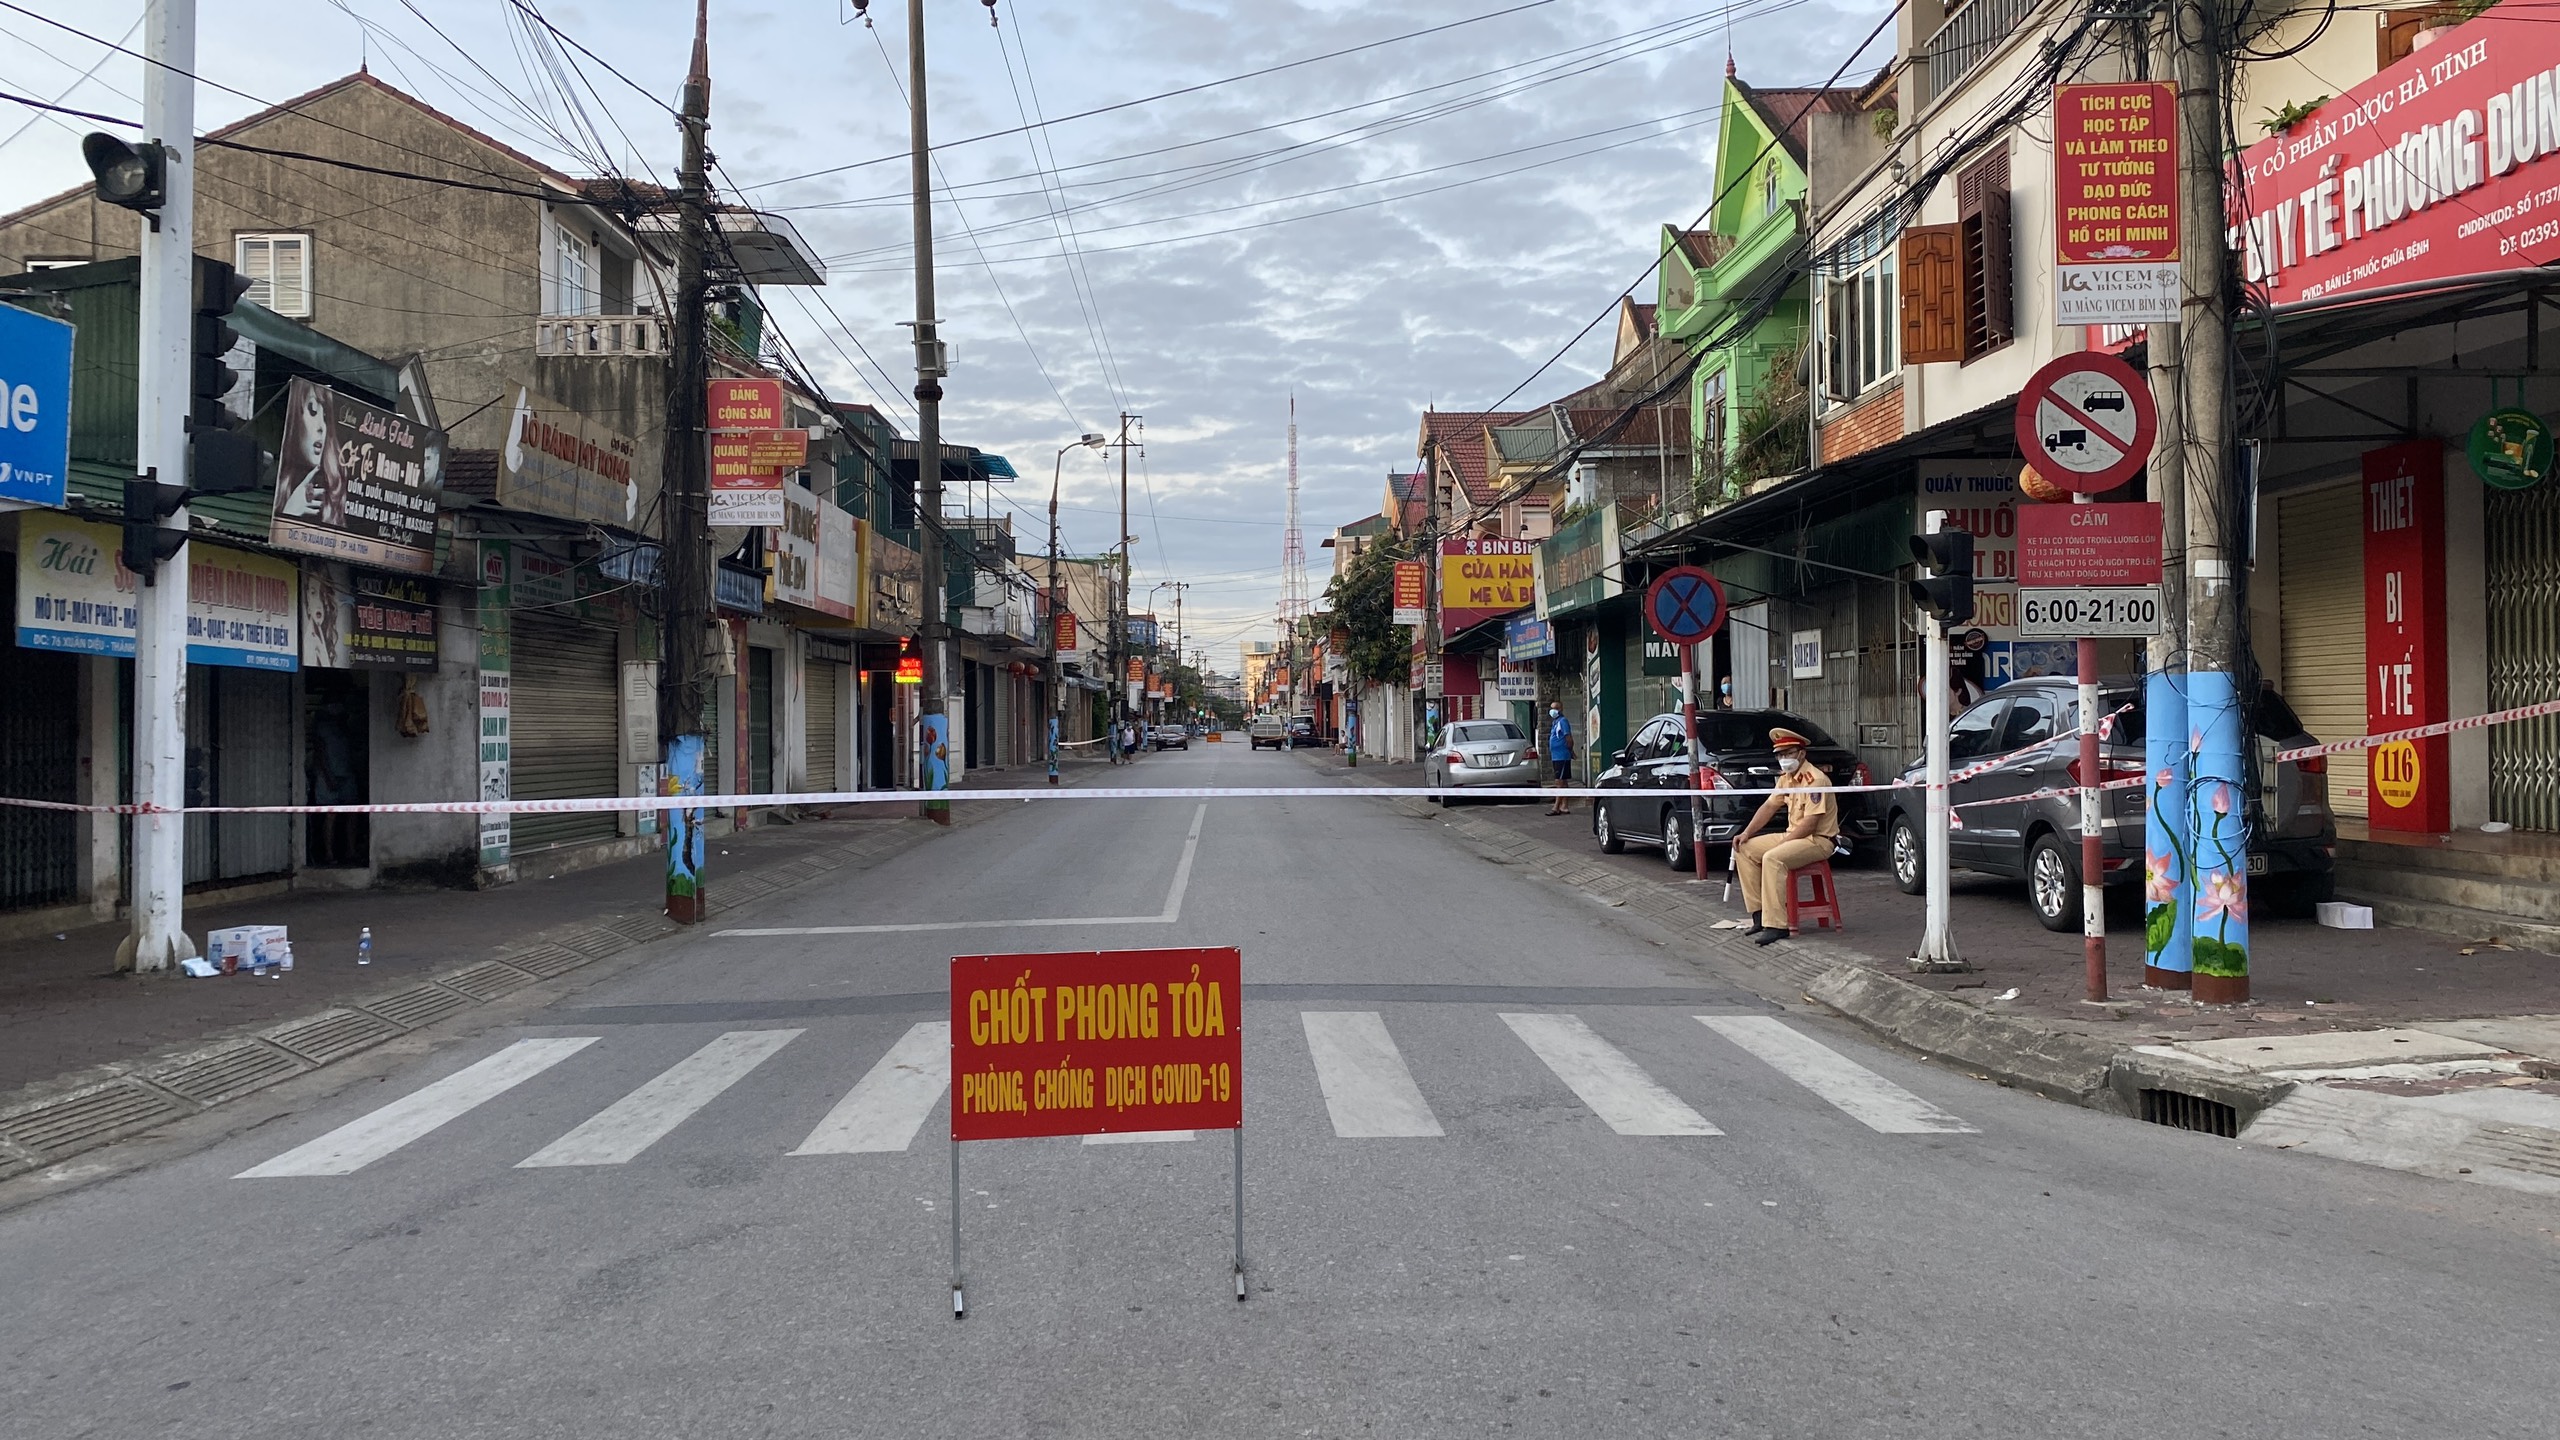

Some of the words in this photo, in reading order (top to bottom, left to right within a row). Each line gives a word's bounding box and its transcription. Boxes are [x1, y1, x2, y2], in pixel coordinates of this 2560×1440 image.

[2080, 96, 2115, 111] TÍCH
[2120, 95, 2152, 113] CỰC
[2263, 138, 2285, 177] CỔ
[2289, 120, 2338, 164] PHẦN
[2342, 90, 2394, 136] DƯỢC
[2399, 74, 2428, 106] HÀ
[2431, 38, 2488, 88] TĨNH
[2083, 118, 2115, 135] HỌC
[2120, 115, 2150, 135] TẬP
[2065, 139, 2086, 155] VÀ
[2090, 137, 2124, 154] LÀM
[2128, 138, 2169, 153] THEO
[2079, 161, 2100, 177] TƯ
[2103, 156, 2155, 176] TƯỞNG
[2083, 184, 2115, 201] ĐẠO
[2119, 180, 2152, 198] ĐỨC
[2276, 197, 2301, 268] Y
[2300, 153, 2343, 258] TẾ
[2343, 108, 2485, 240] PHƯƠNG
[2067, 205, 2122, 221] PHONG
[2126, 202, 2169, 219] CÁCH
[2069, 224, 2090, 243] HỒ
[2095, 226, 2121, 242] CHÍ
[2126, 226, 2168, 241] MINH
[2325, 274, 2342, 292] BÁN
[2352, 255, 2380, 281] THUỐC
[2406, 239, 2430, 261] BỆNH
[2092, 270, 2152, 282] VICEM
[2106, 298, 2135, 312] VICEM
[730, 384, 759, 401] ĐẢNG
[718, 405, 747, 422] CỘNG
[749, 402, 772, 419] SẢN
[521, 411, 541, 448] LÒ
[541, 422, 578, 465] BÁNH
[714, 444, 749, 458] QUANG
[14, 468, 54, 487] VNPT
[716, 461, 747, 475] MUÔN
[2370, 458, 2415, 533] THIẾT
[405, 515, 434, 534] MASSAGE
[2070, 509, 2108, 526] CẤM
[1482, 540, 1510, 554] BIN
[1461, 558, 1495, 579] CỬA
[1469, 586, 1493, 606] MẸ
[1496, 581, 1515, 602] VÀ
[2385, 571, 2403, 634] BỊ
[72, 597, 94, 625] MÁY
[95, 601, 119, 628] PHÁT
[2025, 599, 2155, 624] 6:00-21:00
[481, 691, 503, 708] ROMA
[503, 692, 509, 708] 2
[2381, 747, 2414, 783] 116
[969, 969, 1047, 1046] CHỐT
[1057, 982, 1159, 1041] PHONG
[1168, 963, 1225, 1038] TỎA
[963, 1063, 1028, 1116] PHÒNG,
[1034, 1054, 1094, 1111] CHỐNG
[1105, 1065, 1147, 1113] DỊCH
[1152, 1062, 1231, 1106] COVID-19
